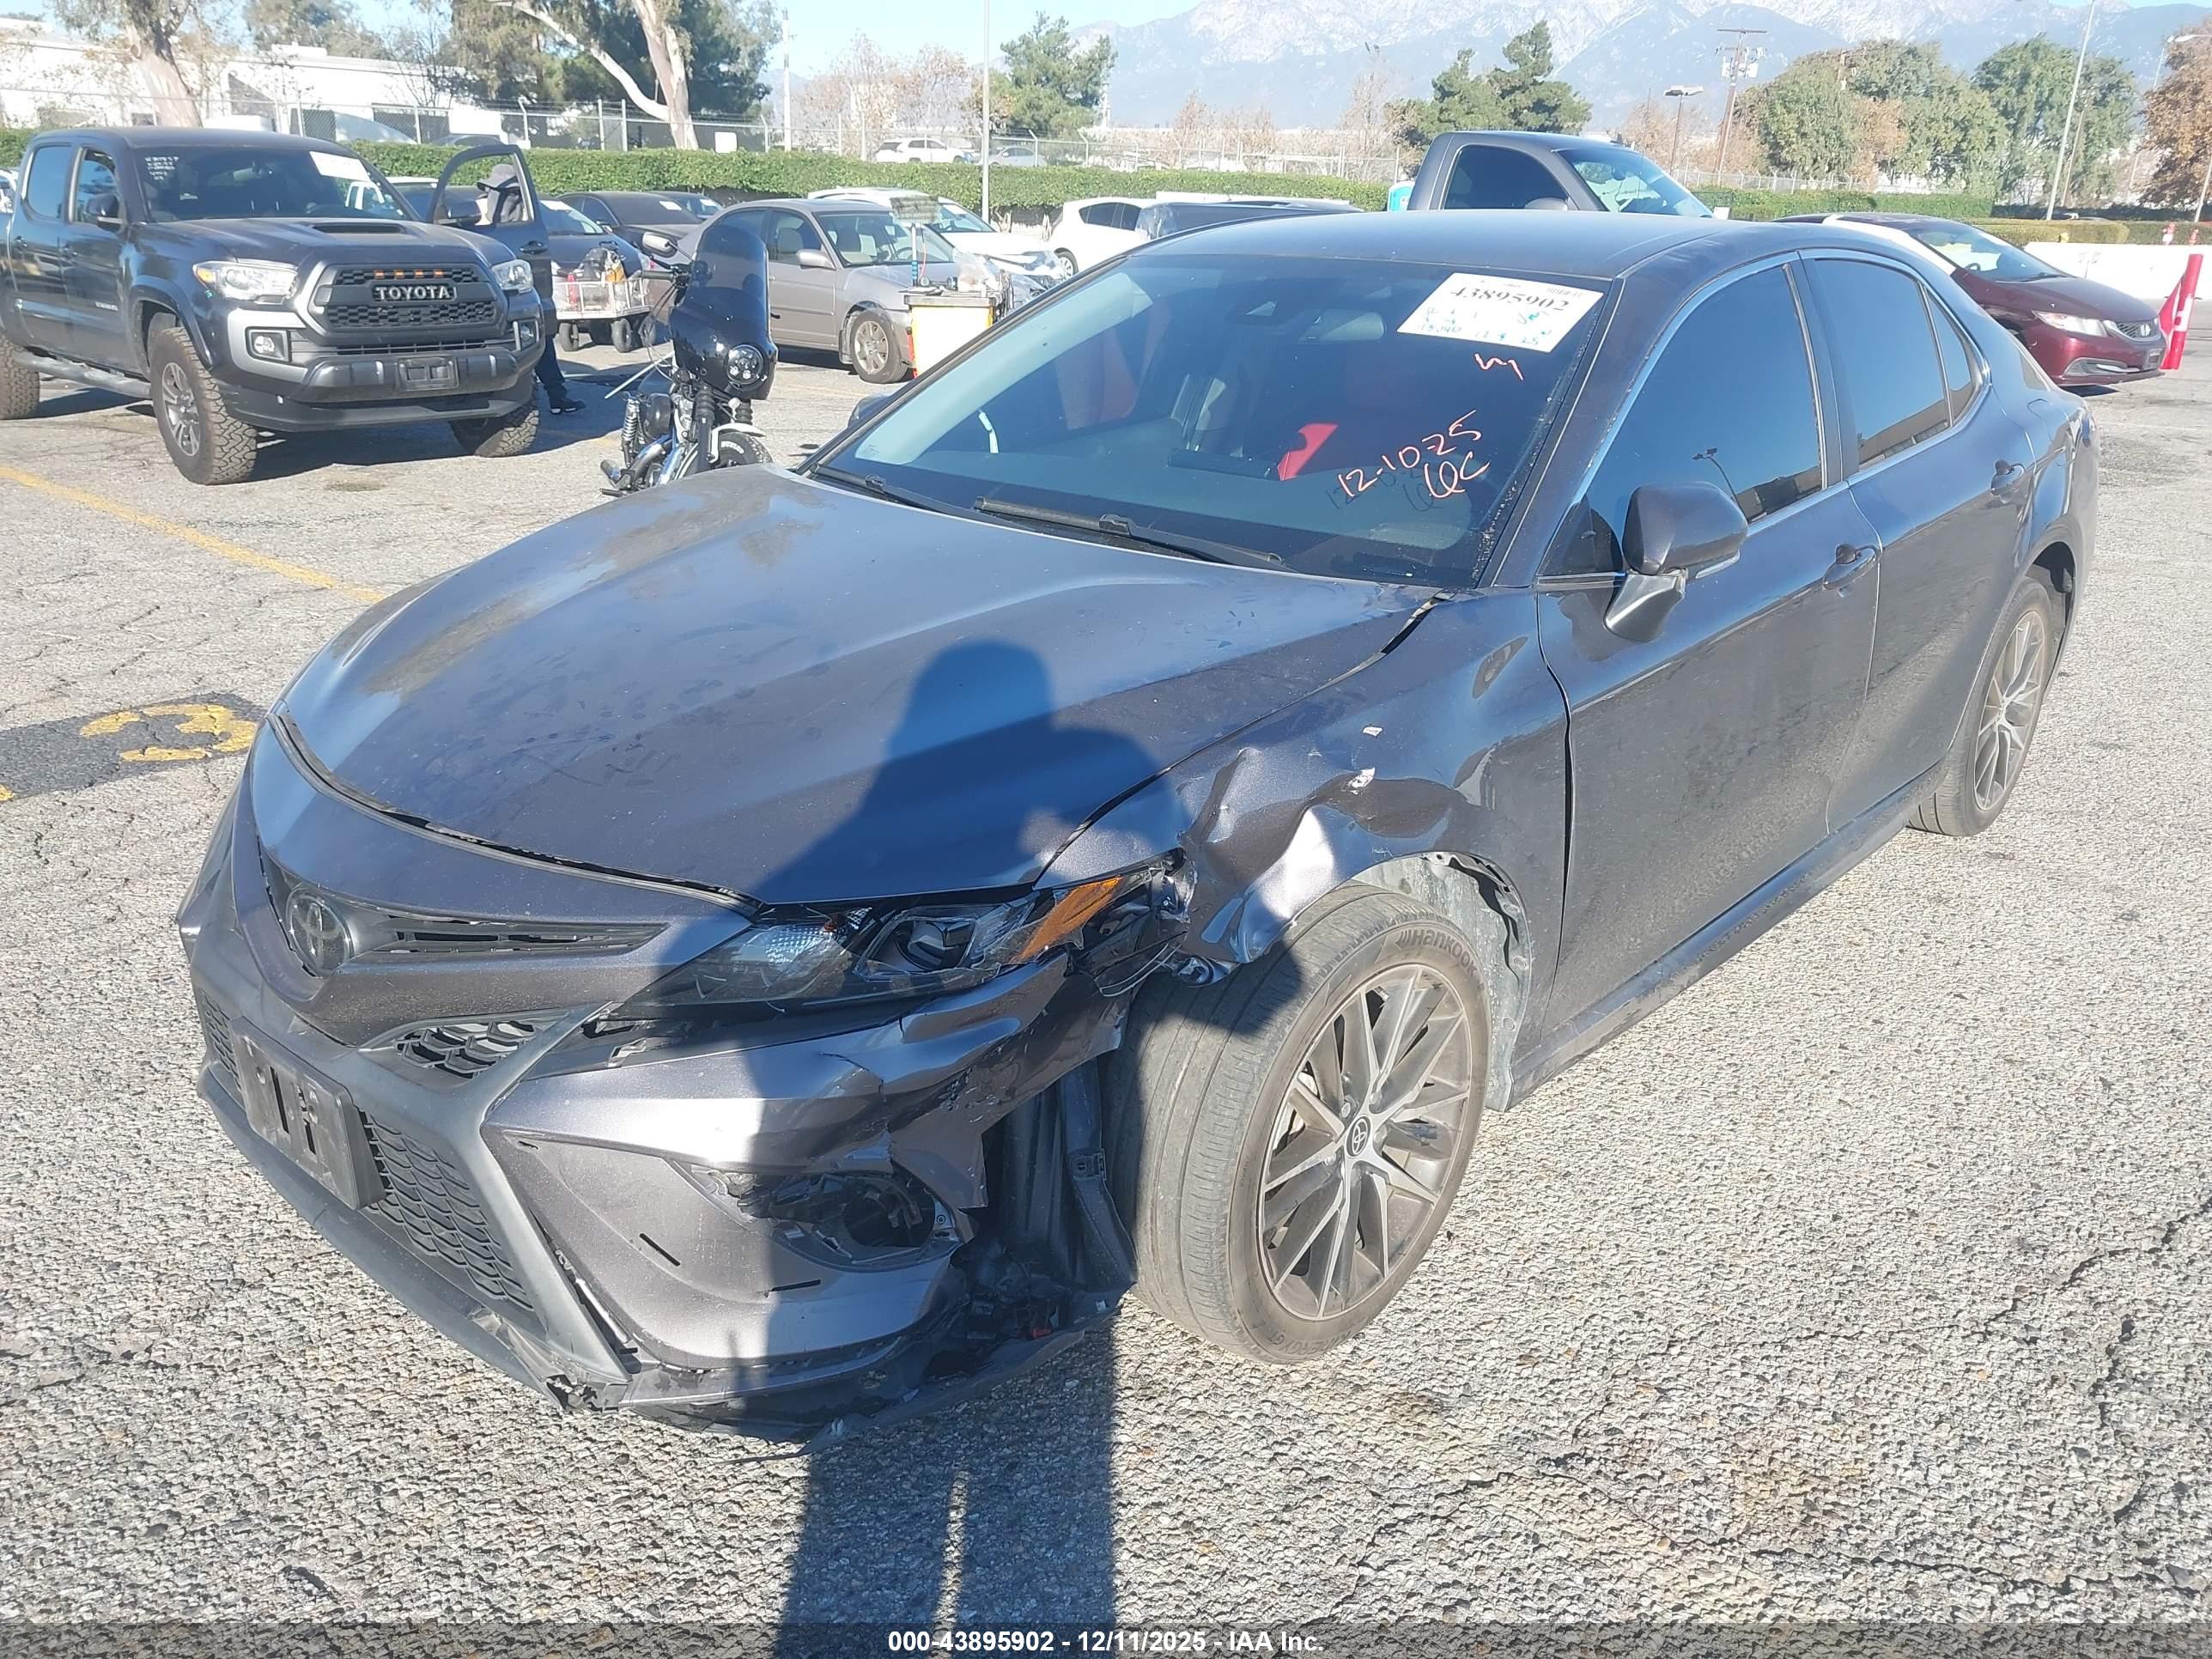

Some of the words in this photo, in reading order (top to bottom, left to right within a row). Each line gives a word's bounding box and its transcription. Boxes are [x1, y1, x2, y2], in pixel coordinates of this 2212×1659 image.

[375, 285, 451, 300] TOYOTA
[1450, 286, 1570, 312] 43895902
[1338, 409, 1482, 498] 12-10-25
